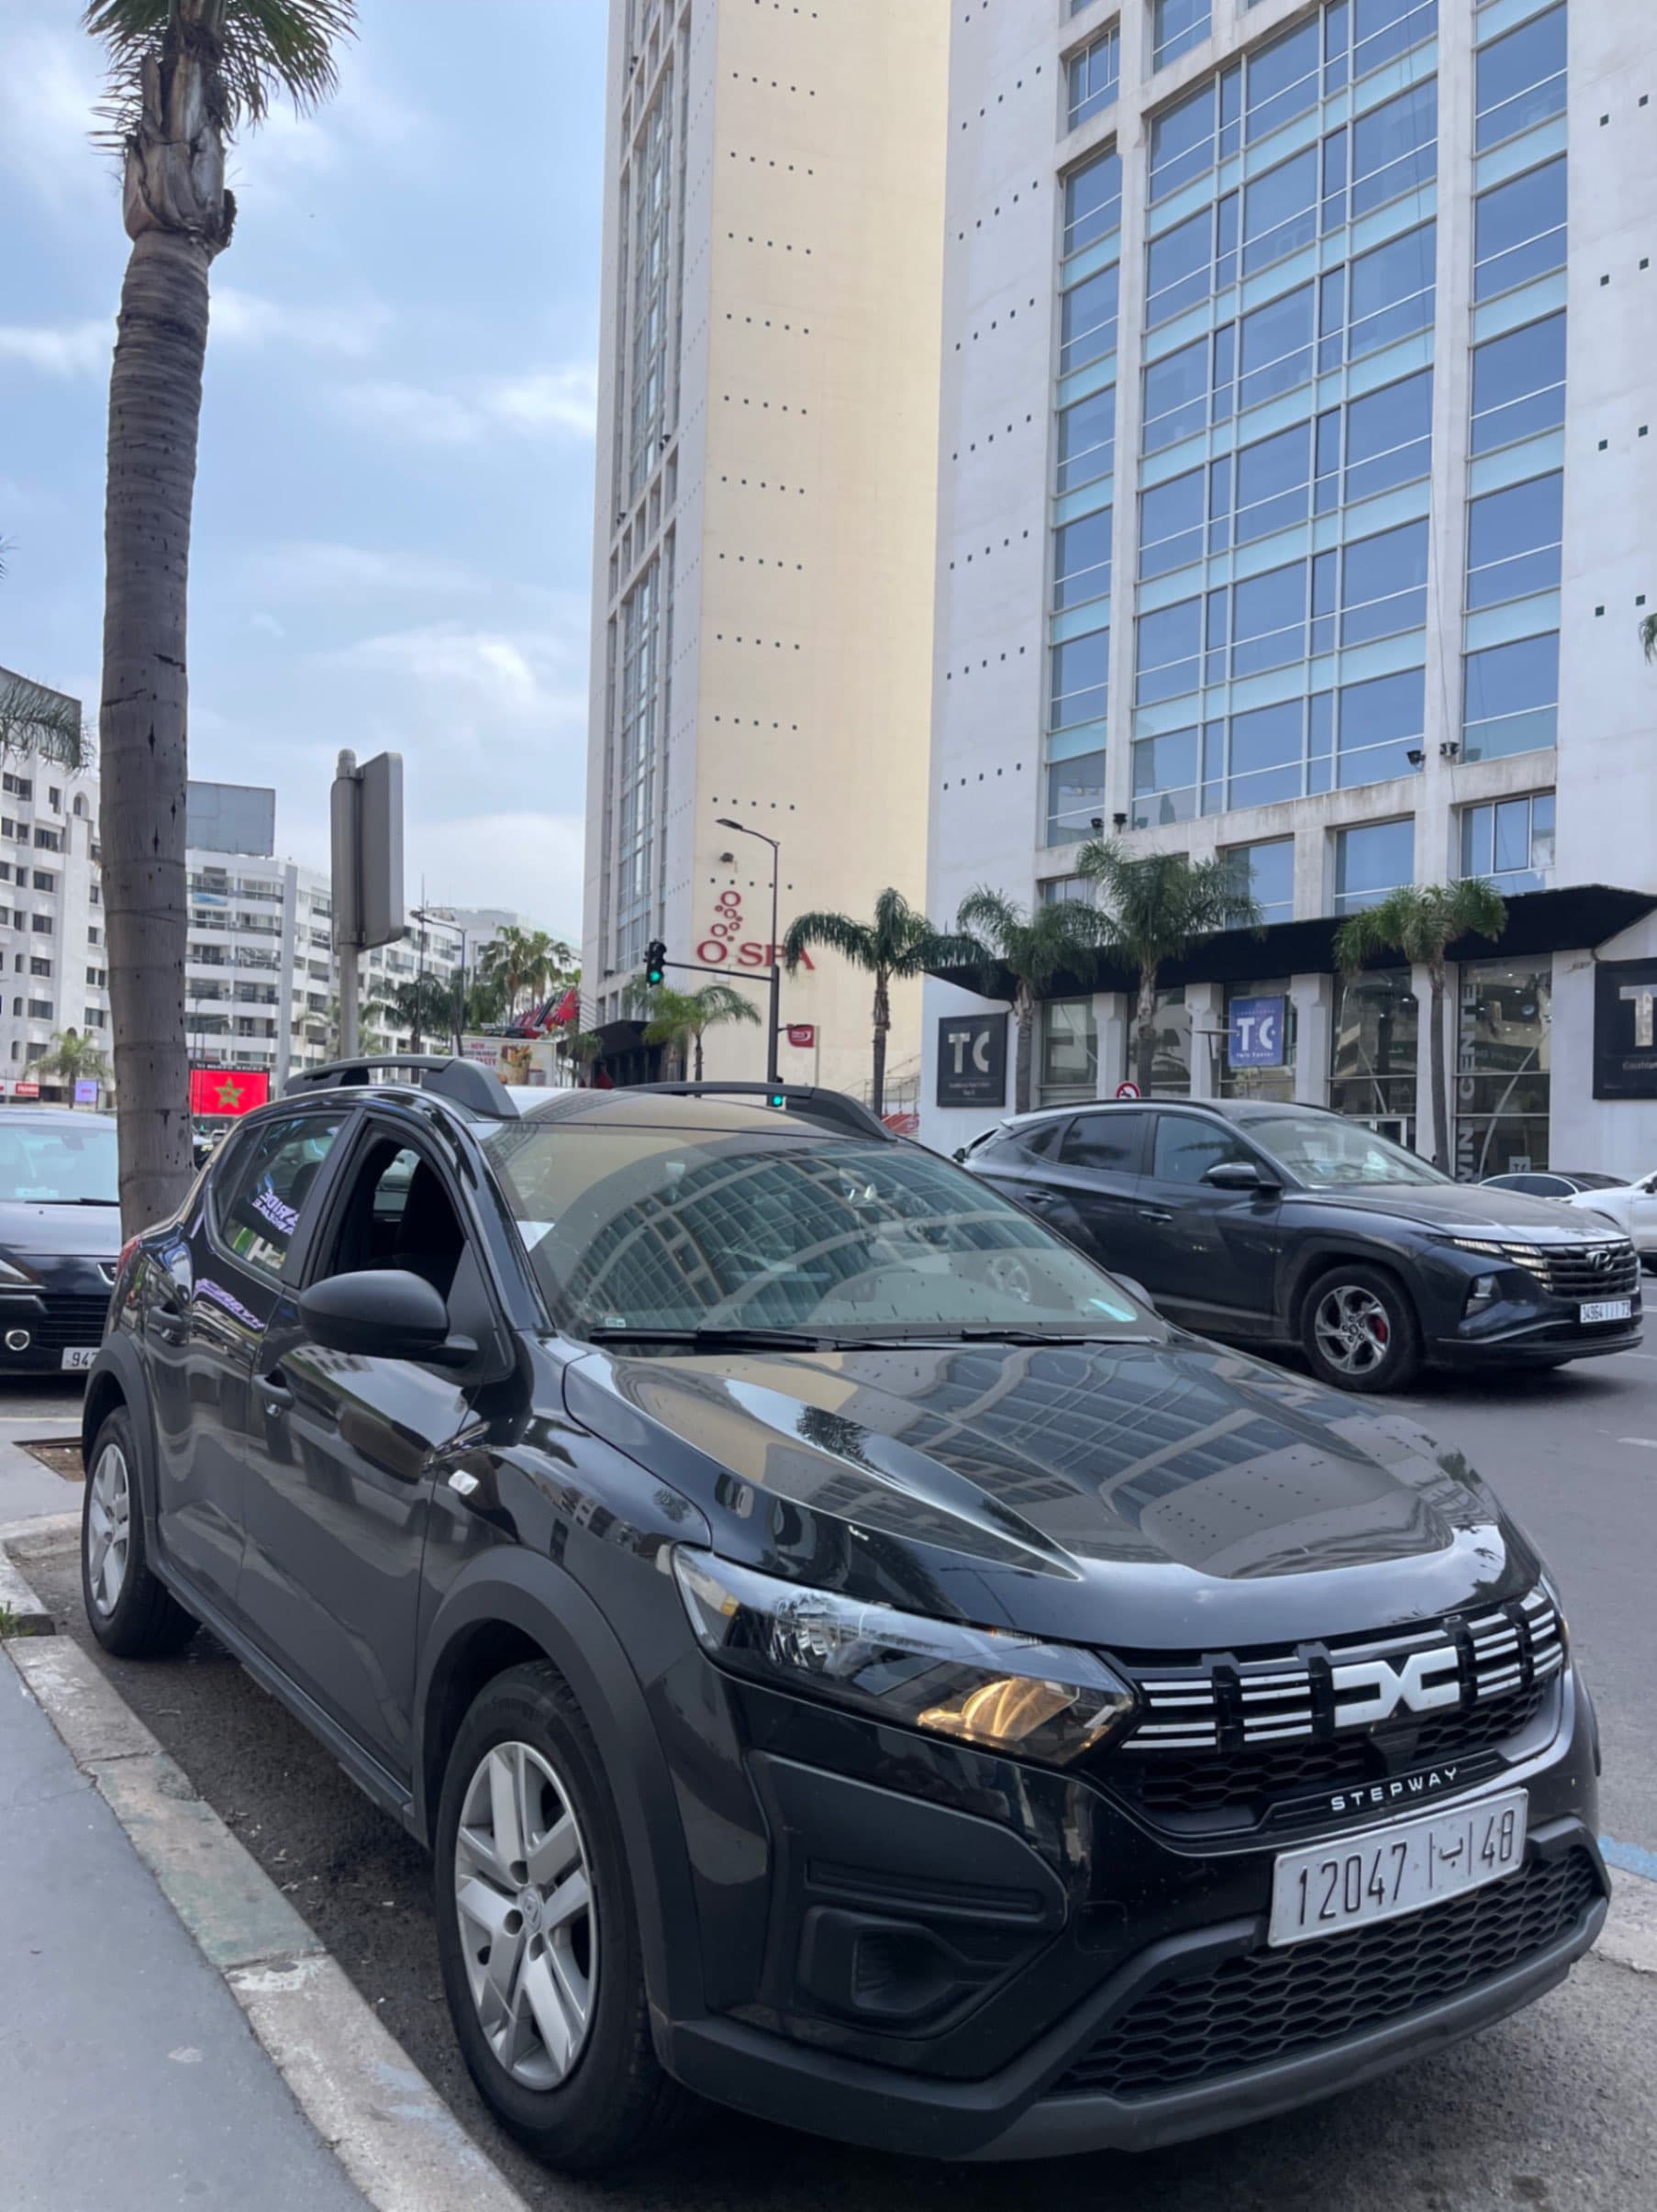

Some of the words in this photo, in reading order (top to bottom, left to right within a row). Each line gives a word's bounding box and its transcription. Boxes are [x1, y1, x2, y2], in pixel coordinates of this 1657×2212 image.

[948, 1030, 990, 1073] TC
[1237, 1016, 1273, 1050] TC
[1331, 1767, 1457, 1811] STEPWAY
[1299, 1840, 1407, 1926] 12047
[1482, 1806, 1515, 1868] 48
